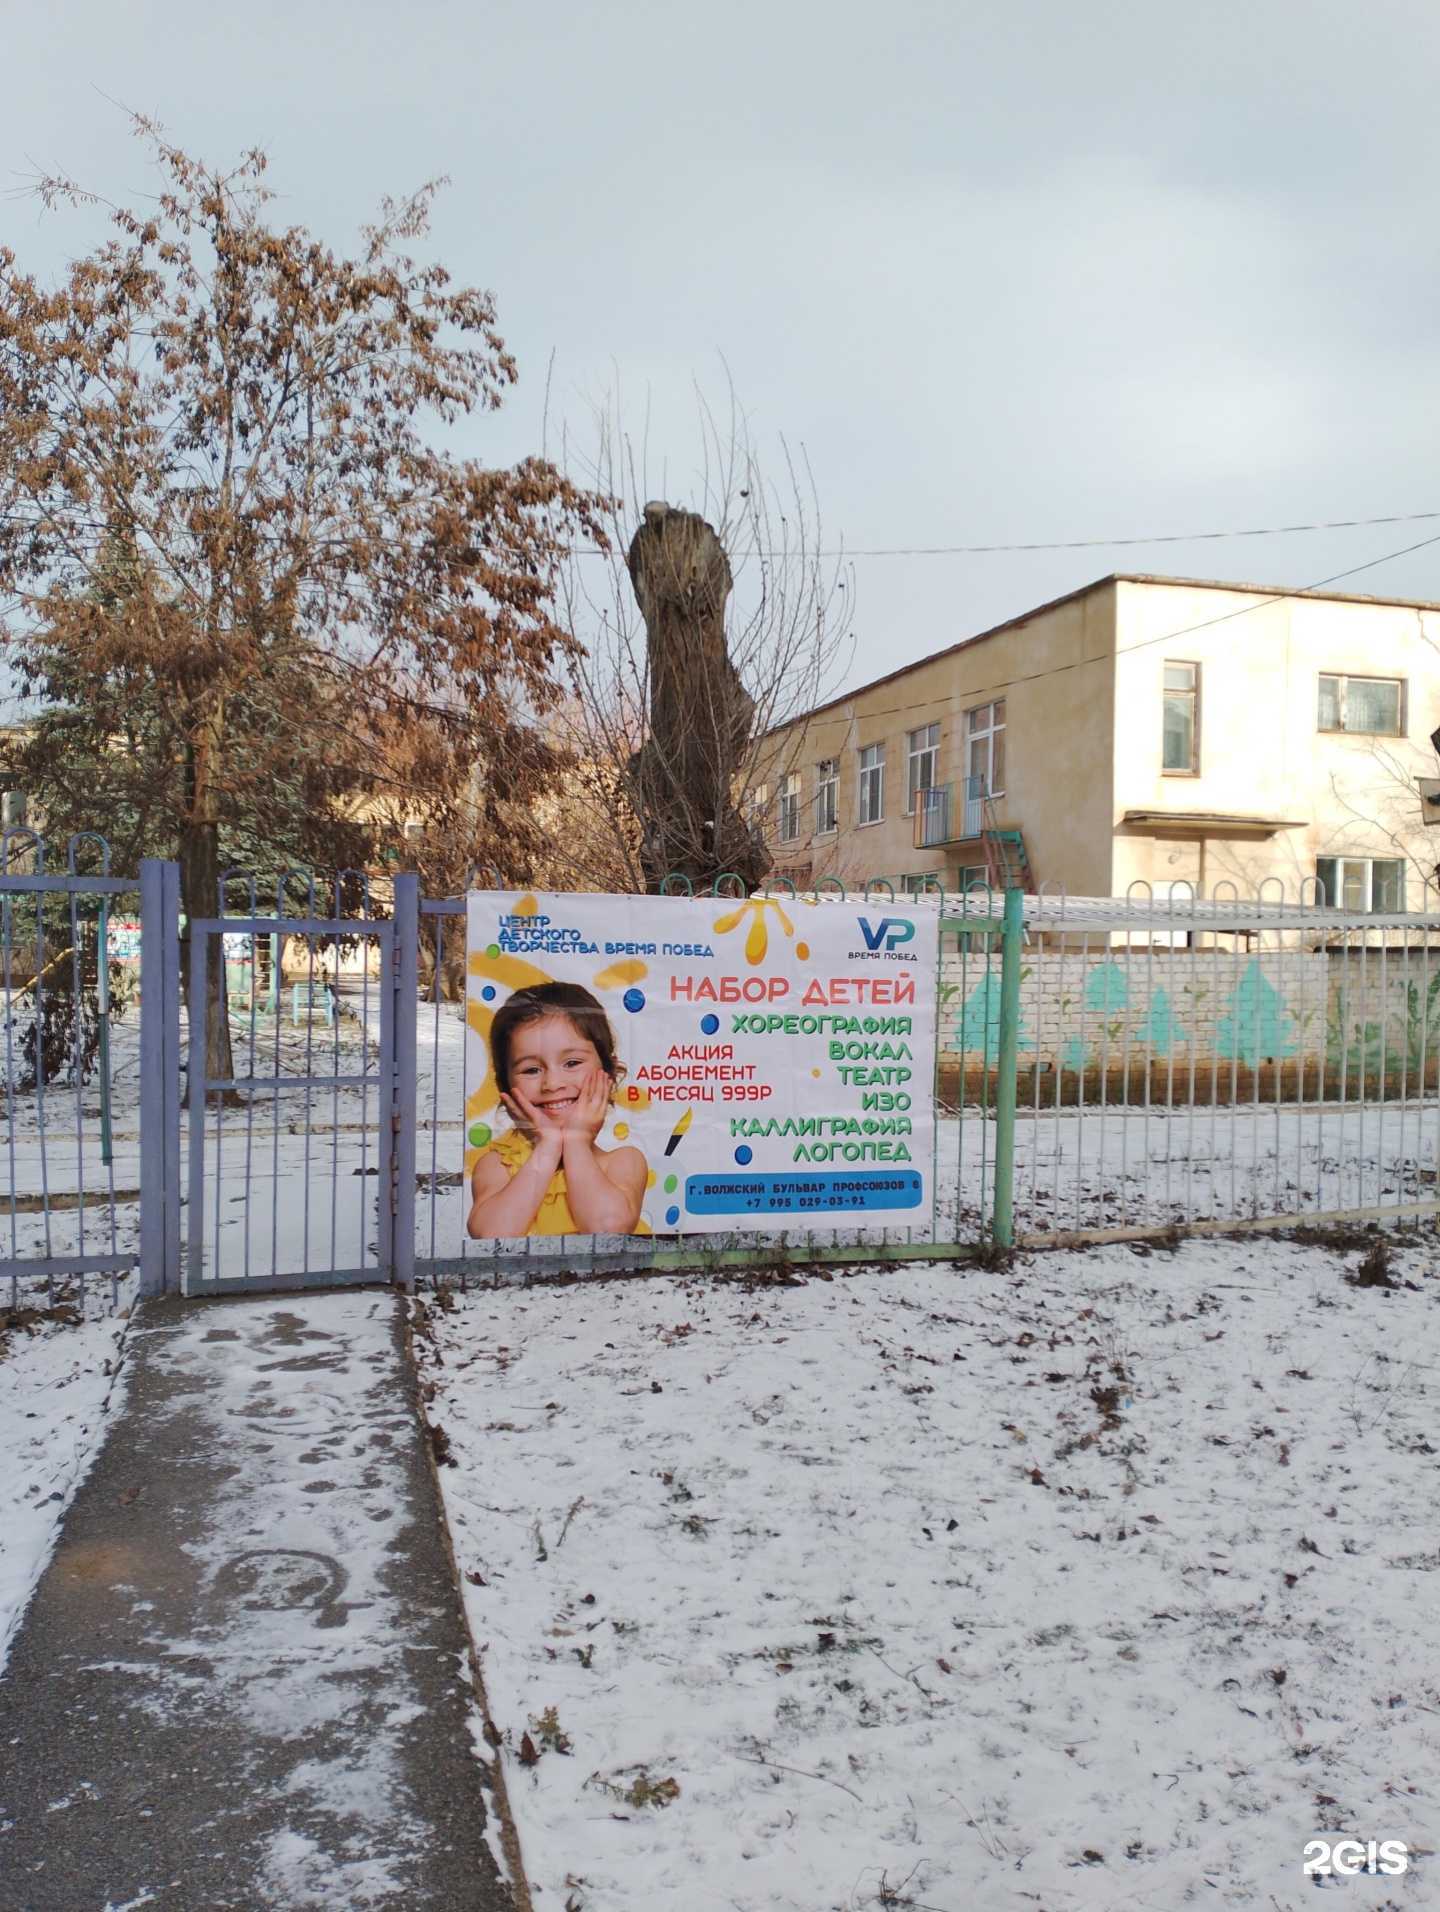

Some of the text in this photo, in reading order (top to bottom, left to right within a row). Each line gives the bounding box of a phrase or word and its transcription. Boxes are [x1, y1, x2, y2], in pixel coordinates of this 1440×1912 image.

[499, 914, 551, 929] ЦЕНТР
[498, 928, 582, 941] ДЕТСКОГО
[857, 917, 915, 951] VP
[501, 940, 714, 957] ТВОРЧЕСТВА ВРЕМЯ ПОБЕД
[848, 952, 918, 961] ВРЕМЯ ПОБЕД
[670, 972, 916, 1006] НАБОР ДЕТЕЙ
[731, 1014, 912, 1035] ХОРЕОГРАФИЯ
[668, 1045, 734, 1061] АКЦИЯ
[829, 1040, 913, 1061] ВОКАЛ
[636, 1065, 757, 1081] АБОНЕМЕНТ
[836, 1066, 912, 1086] ТЕАТР
[627, 1086, 772, 1102] В МЕСЯЦ 999Р
[862, 1092, 912, 1112] ИЗО
[730, 1117, 912, 1137] КАЛЛИГРАФИЯ
[792, 1141, 912, 1162] ЛОГОПЕД
[772, 1183, 826, 1193] БУЛЬВАР
[832, 1181, 905, 1192] ПРОФСОЮЗОВ
[746, 1199, 760, 1208] +7
